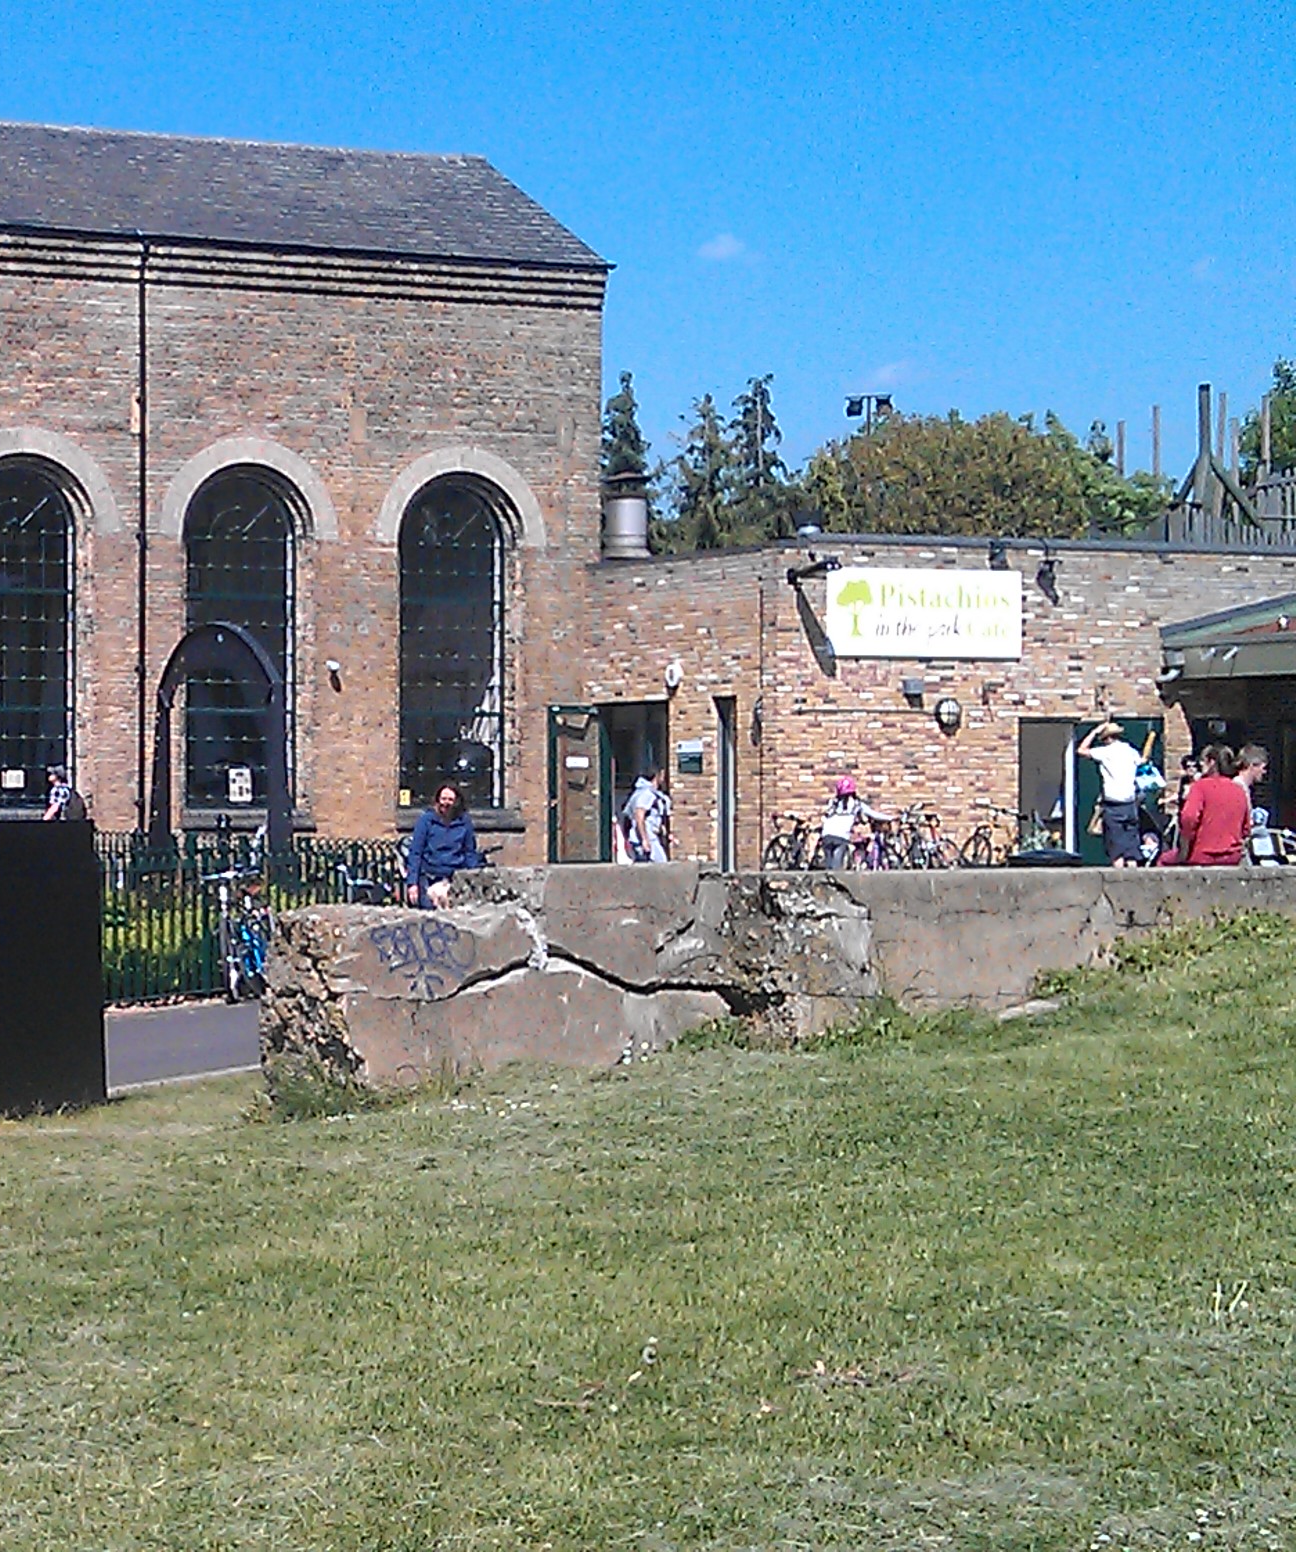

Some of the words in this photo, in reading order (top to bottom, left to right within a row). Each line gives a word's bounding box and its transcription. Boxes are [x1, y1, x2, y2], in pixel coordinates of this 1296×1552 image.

[880, 583, 1010, 609] Pistachios
[876, 614, 890, 636] in
[897, 617, 917, 636] the
